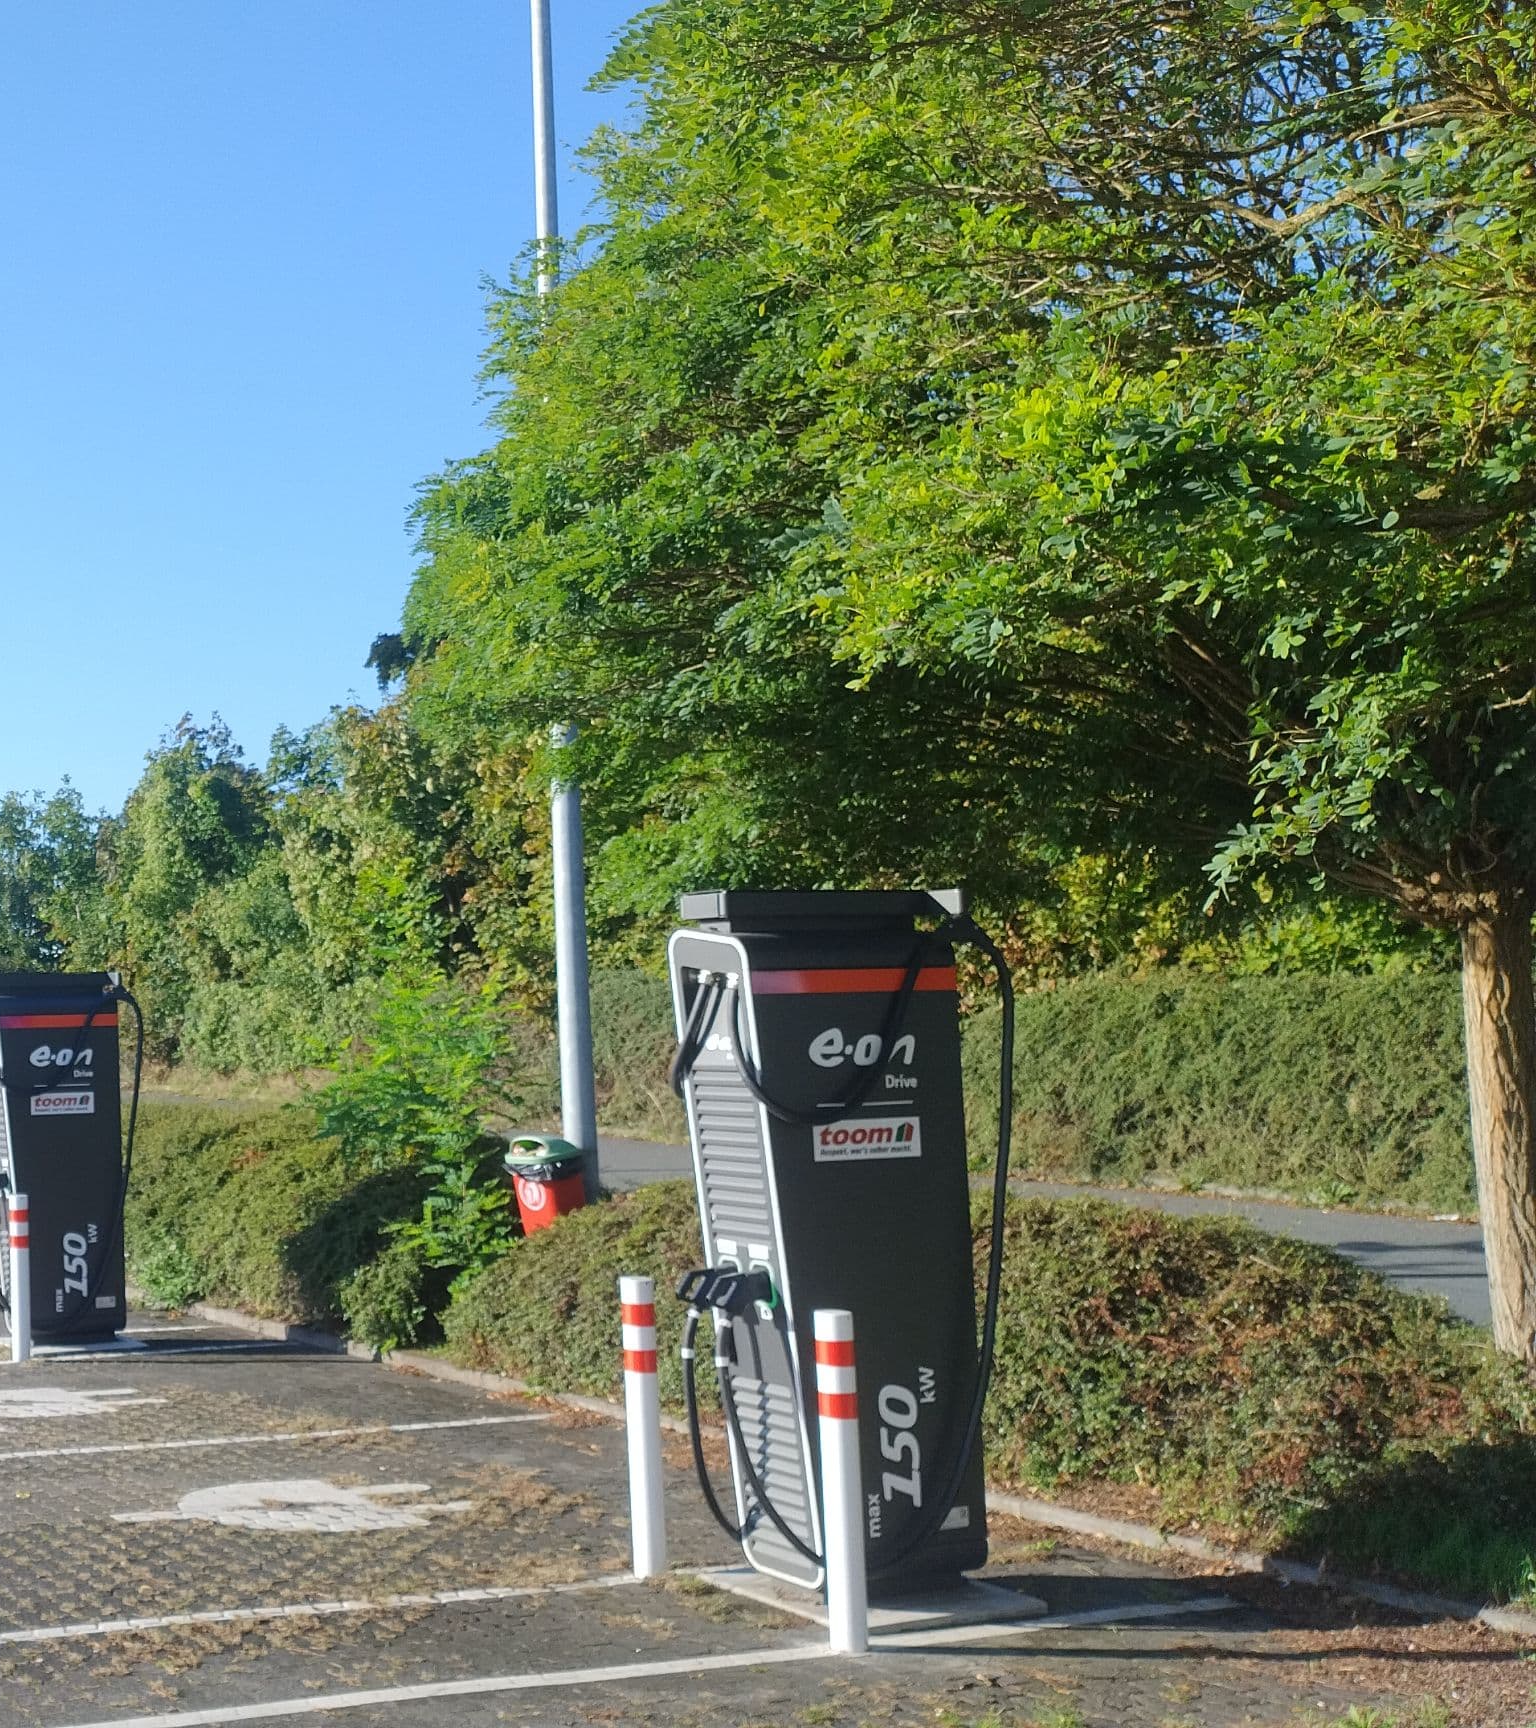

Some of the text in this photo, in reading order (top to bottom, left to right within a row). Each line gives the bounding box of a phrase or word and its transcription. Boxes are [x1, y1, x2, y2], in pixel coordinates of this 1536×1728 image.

[885, 1074, 918, 1089] Drive
[35, 1096, 77, 1107] toom
[819, 1125, 894, 1147] toom
[63, 1232, 88, 1297] 150
[87, 1223, 98, 1243] kW
[868, 1366, 936, 1539] max 150 kW
